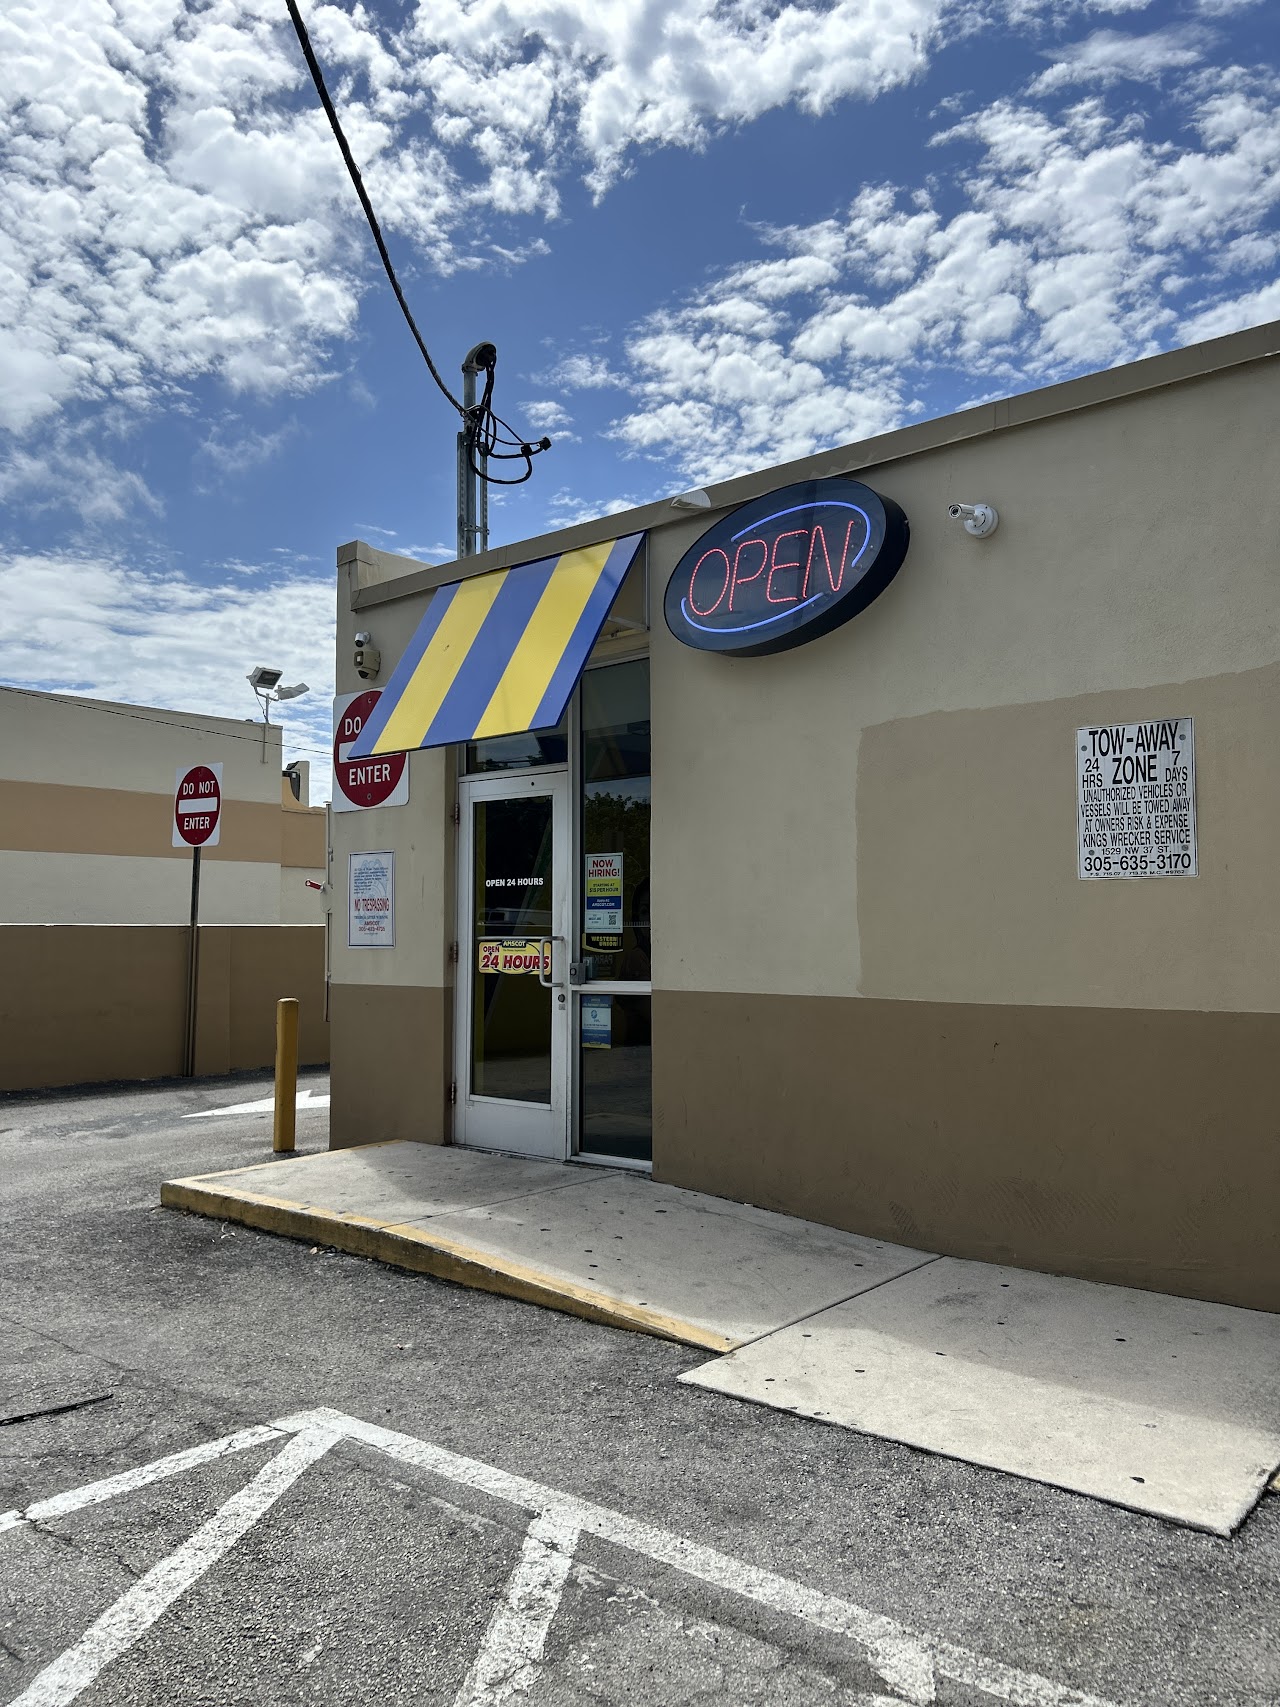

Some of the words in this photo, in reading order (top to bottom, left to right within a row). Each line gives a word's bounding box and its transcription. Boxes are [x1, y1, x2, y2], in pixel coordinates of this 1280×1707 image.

[690, 520, 854, 616] OPEN
[344, 716, 362, 736] DO
[1088, 721, 1179, 757] TOW-AWAY
[1084, 757, 1100, 773] 24
[1171, 750, 1181, 766] 7
[348, 763, 391, 787] ENTER
[1111, 754, 1158, 785] ZONE
[1165, 766, 1188, 783] DAYS
[182, 782, 195, 796] DO
[198, 780, 216, 794] NOT
[1082, 773, 1103, 788] HRS
[1083, 786, 1136, 803] UNAUTHORIZED
[1138, 784, 1174, 799] VEHICLES
[1176, 782, 1187, 797] OR
[1080, 802, 1111, 818] VESSELS
[1113, 801, 1130, 816] WILL
[1132, 800, 1142, 815] BE
[1144, 799, 1170, 814] TOWED
[1172, 797, 1191, 812] AWAY
[183, 816, 210, 830] ENTER
[1084, 818, 1093, 833] AT
[1094, 817, 1125, 832] OWNERS
[1127, 816, 1144, 831] RISK
[1146, 815, 1152, 829] &
[1154, 814, 1189, 829] EXPENSE
[1083, 832, 1107, 848] KINGS
[1109, 831, 1151, 846] WRECKER
[1154, 829, 1191, 845] SERVICE
[1101, 847, 1121, 856] 1529
[1124, 846, 1140, 854] NW
[1142, 846, 1154, 854] 37
[1157, 845, 1172, 853] ST.
[592, 859, 614, 868] NOW
[1084, 853, 1192, 872] 305-635-3170
[588, 868, 620, 878] HIRING!
[485, 879, 505, 888] OPEN
[506, 878, 516, 887] 24
[517, 877, 544, 886] HOURS
[354, 898, 361, 912] NO
[362, 897, 390, 912] TRESPASSING
[482, 945, 500, 953] OPEN
[481, 954, 500, 969] 24
[502, 954, 550, 970] HOURS
